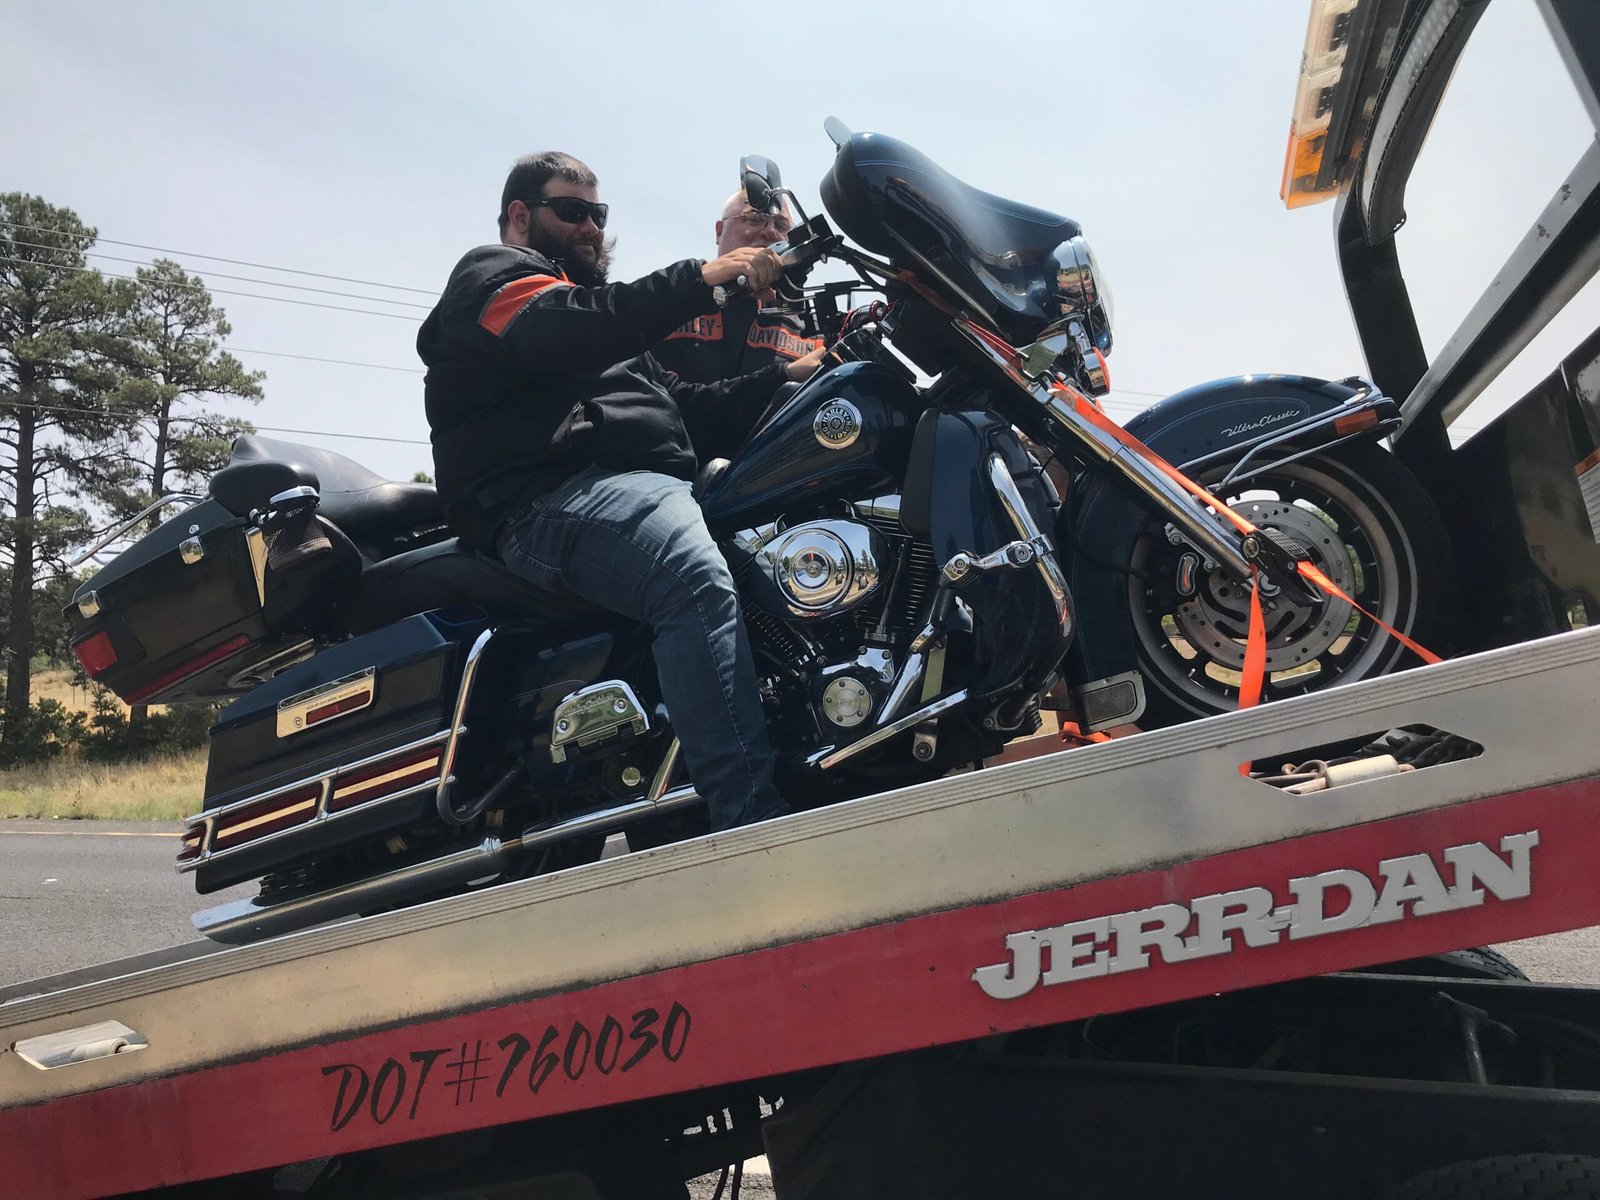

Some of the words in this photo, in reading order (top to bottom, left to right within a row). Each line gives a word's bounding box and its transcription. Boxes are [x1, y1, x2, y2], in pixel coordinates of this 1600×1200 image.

[749, 323, 814, 355] DAVIDSON
[822, 407, 849, 423] HARLEY
[822, 420, 853, 440] DAVIDSON
[971, 828, 1540, 1000] JERR-DAN
